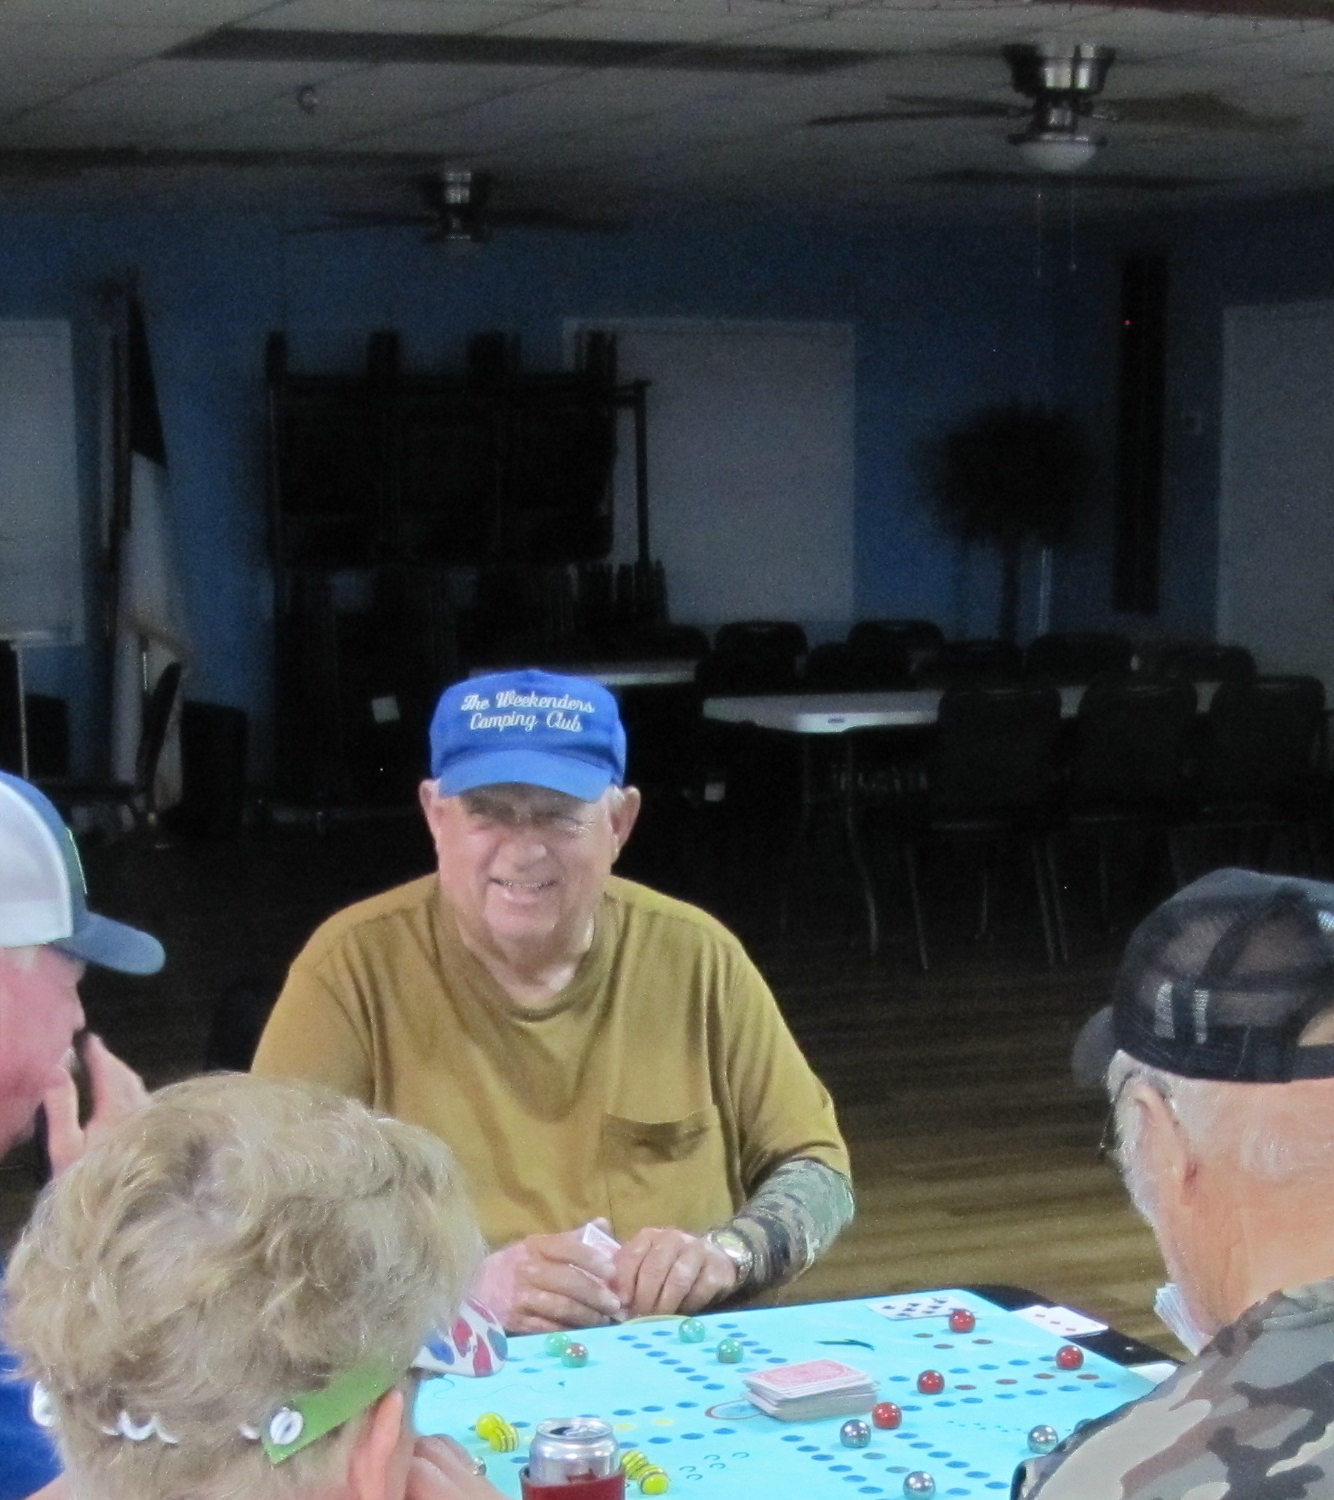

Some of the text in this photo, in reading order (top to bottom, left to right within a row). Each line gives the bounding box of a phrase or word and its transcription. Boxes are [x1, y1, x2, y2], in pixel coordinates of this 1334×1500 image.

[461, 689, 596, 714] The Weekenders
[470, 711, 583, 732] Camping Club
